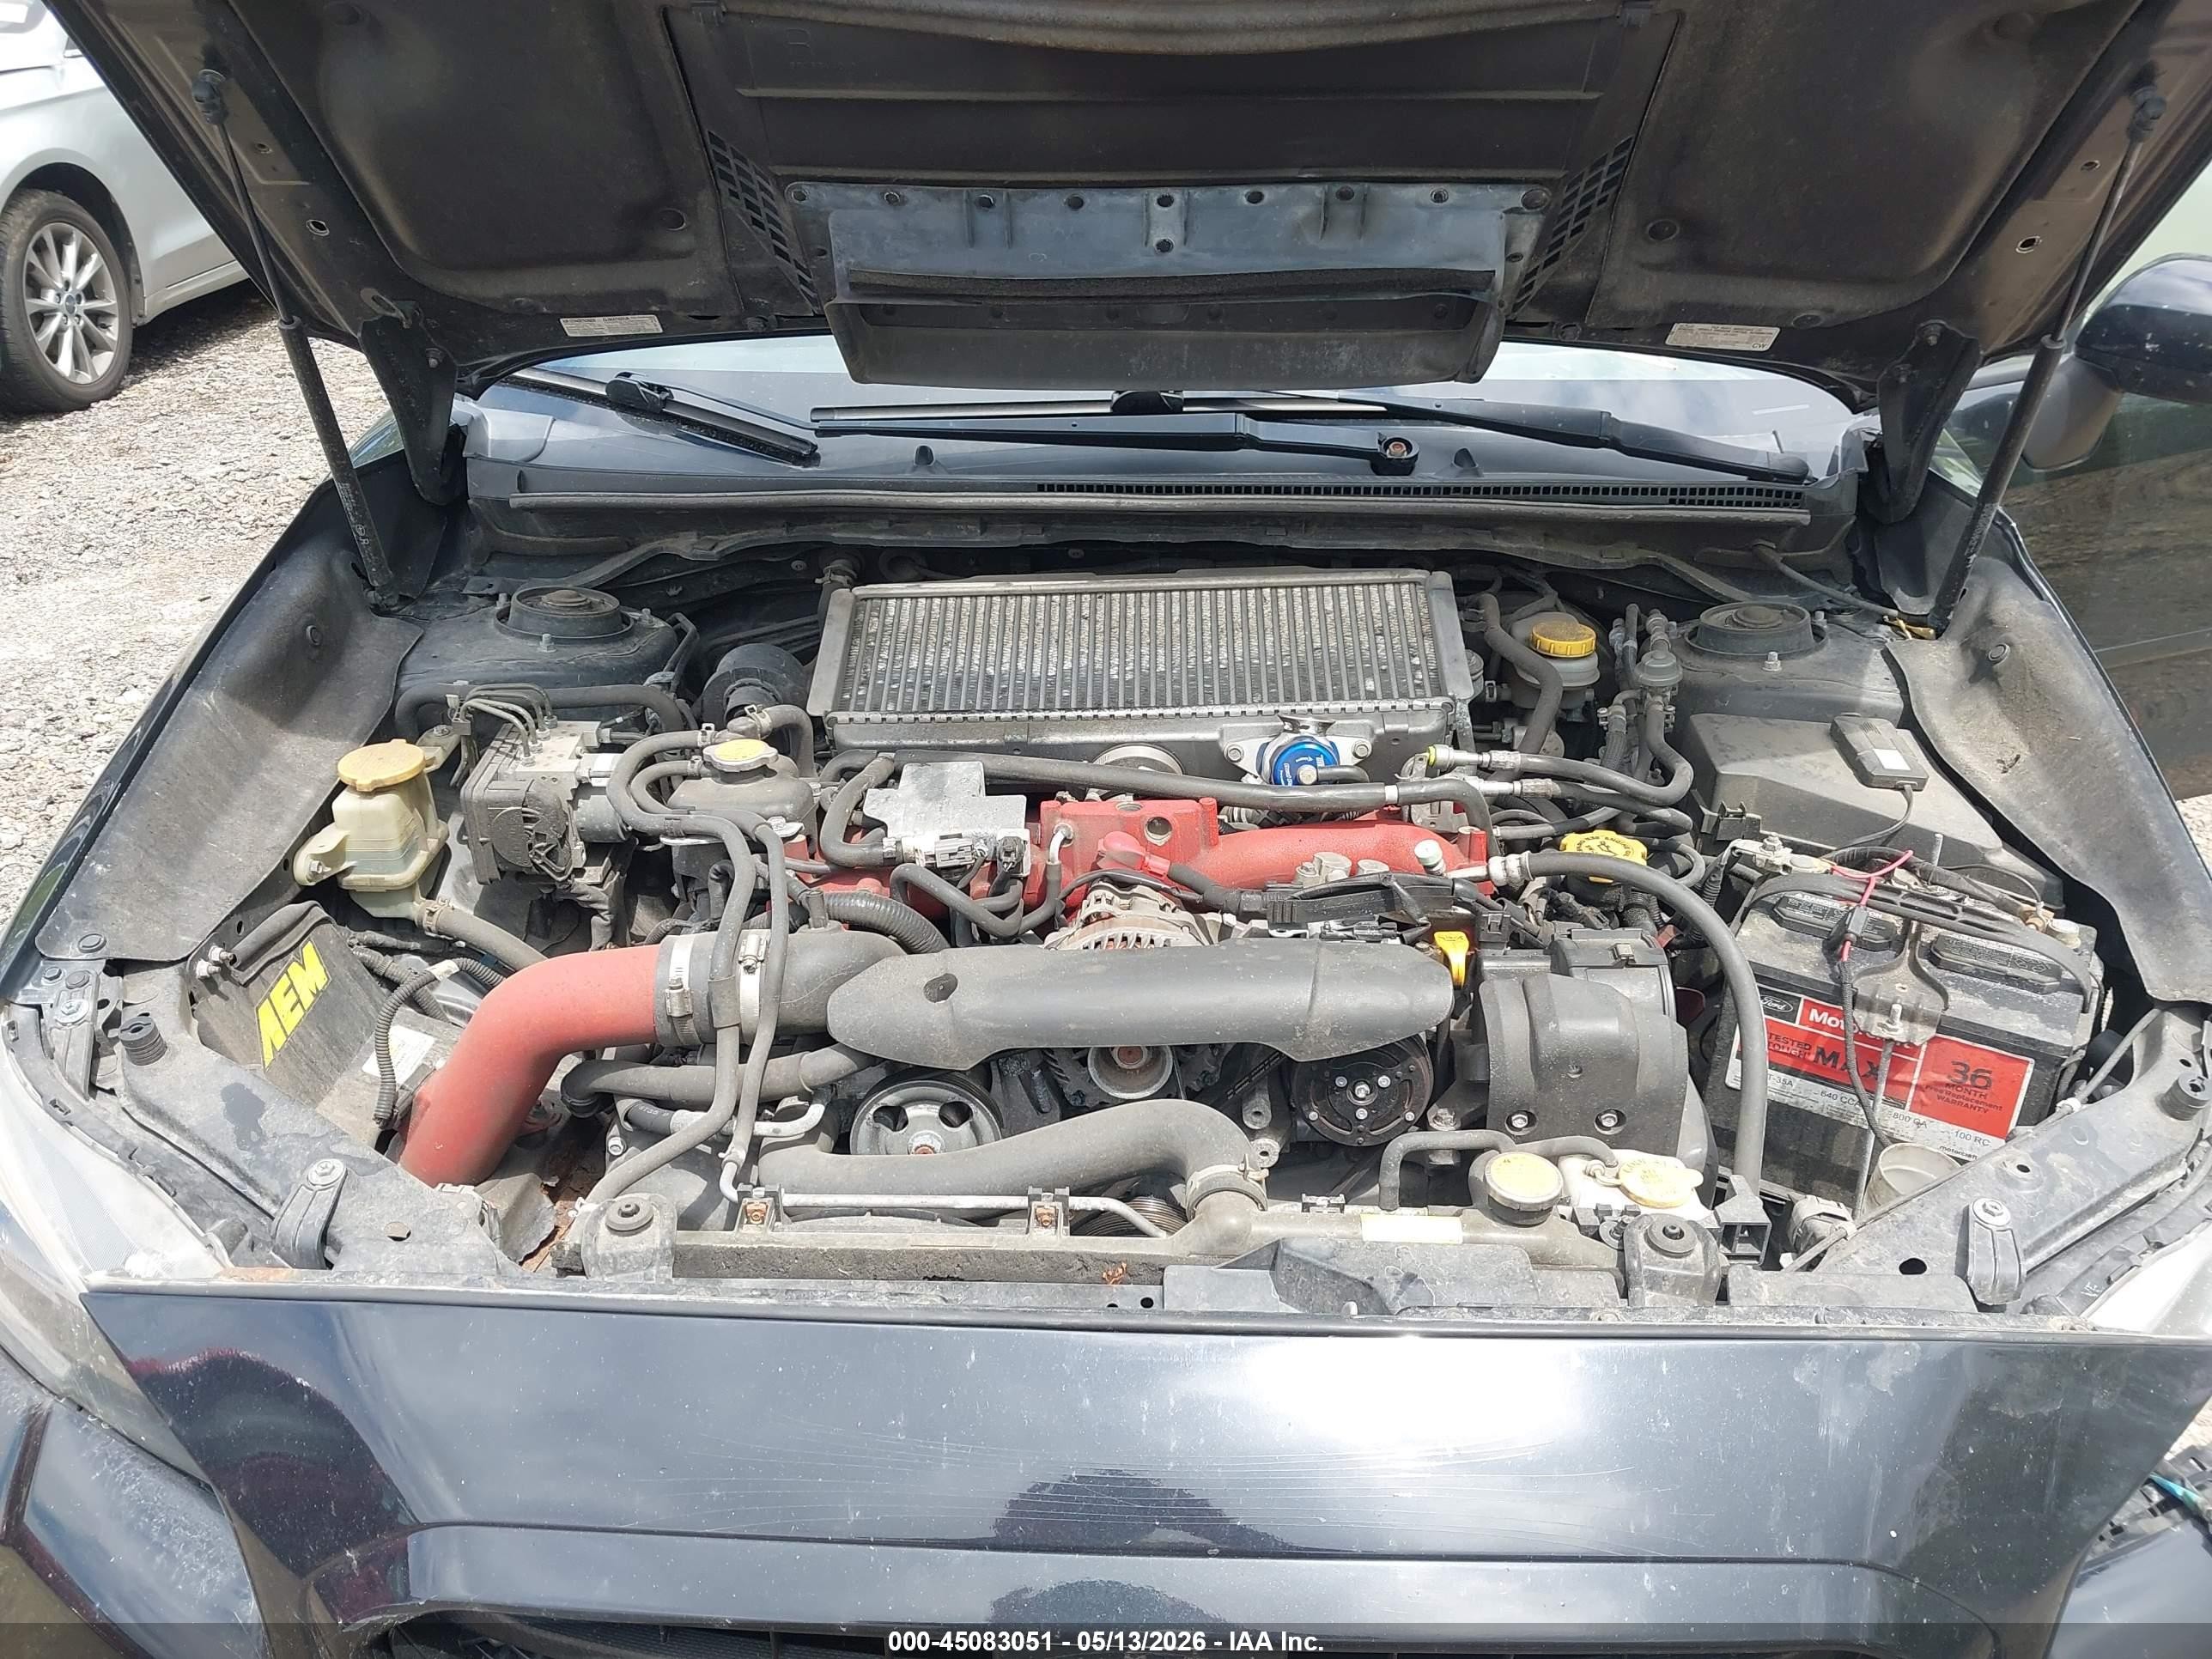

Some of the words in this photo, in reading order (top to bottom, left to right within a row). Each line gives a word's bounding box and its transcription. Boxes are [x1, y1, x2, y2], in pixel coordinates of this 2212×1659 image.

[1803, 894, 1840, 908] DANGER
[258, 940, 328, 1068] AEM
[1760, 996, 1786, 1012] Ford
[1769, 1033, 1812, 1050] TESTED
[1814, 1046, 1879, 1081] MX
[1948, 1060, 1992, 1090] 36
[1820, 1091, 1838, 1101] 640
[1945, 1083, 1988, 1099] MONTH
[1936, 1095, 1990, 1114] WARRANTY
[1946, 1090, 2003, 1110] Replacement
[1954, 1130, 1972, 1141] 100
[1974, 1135, 1991, 1146] RC
